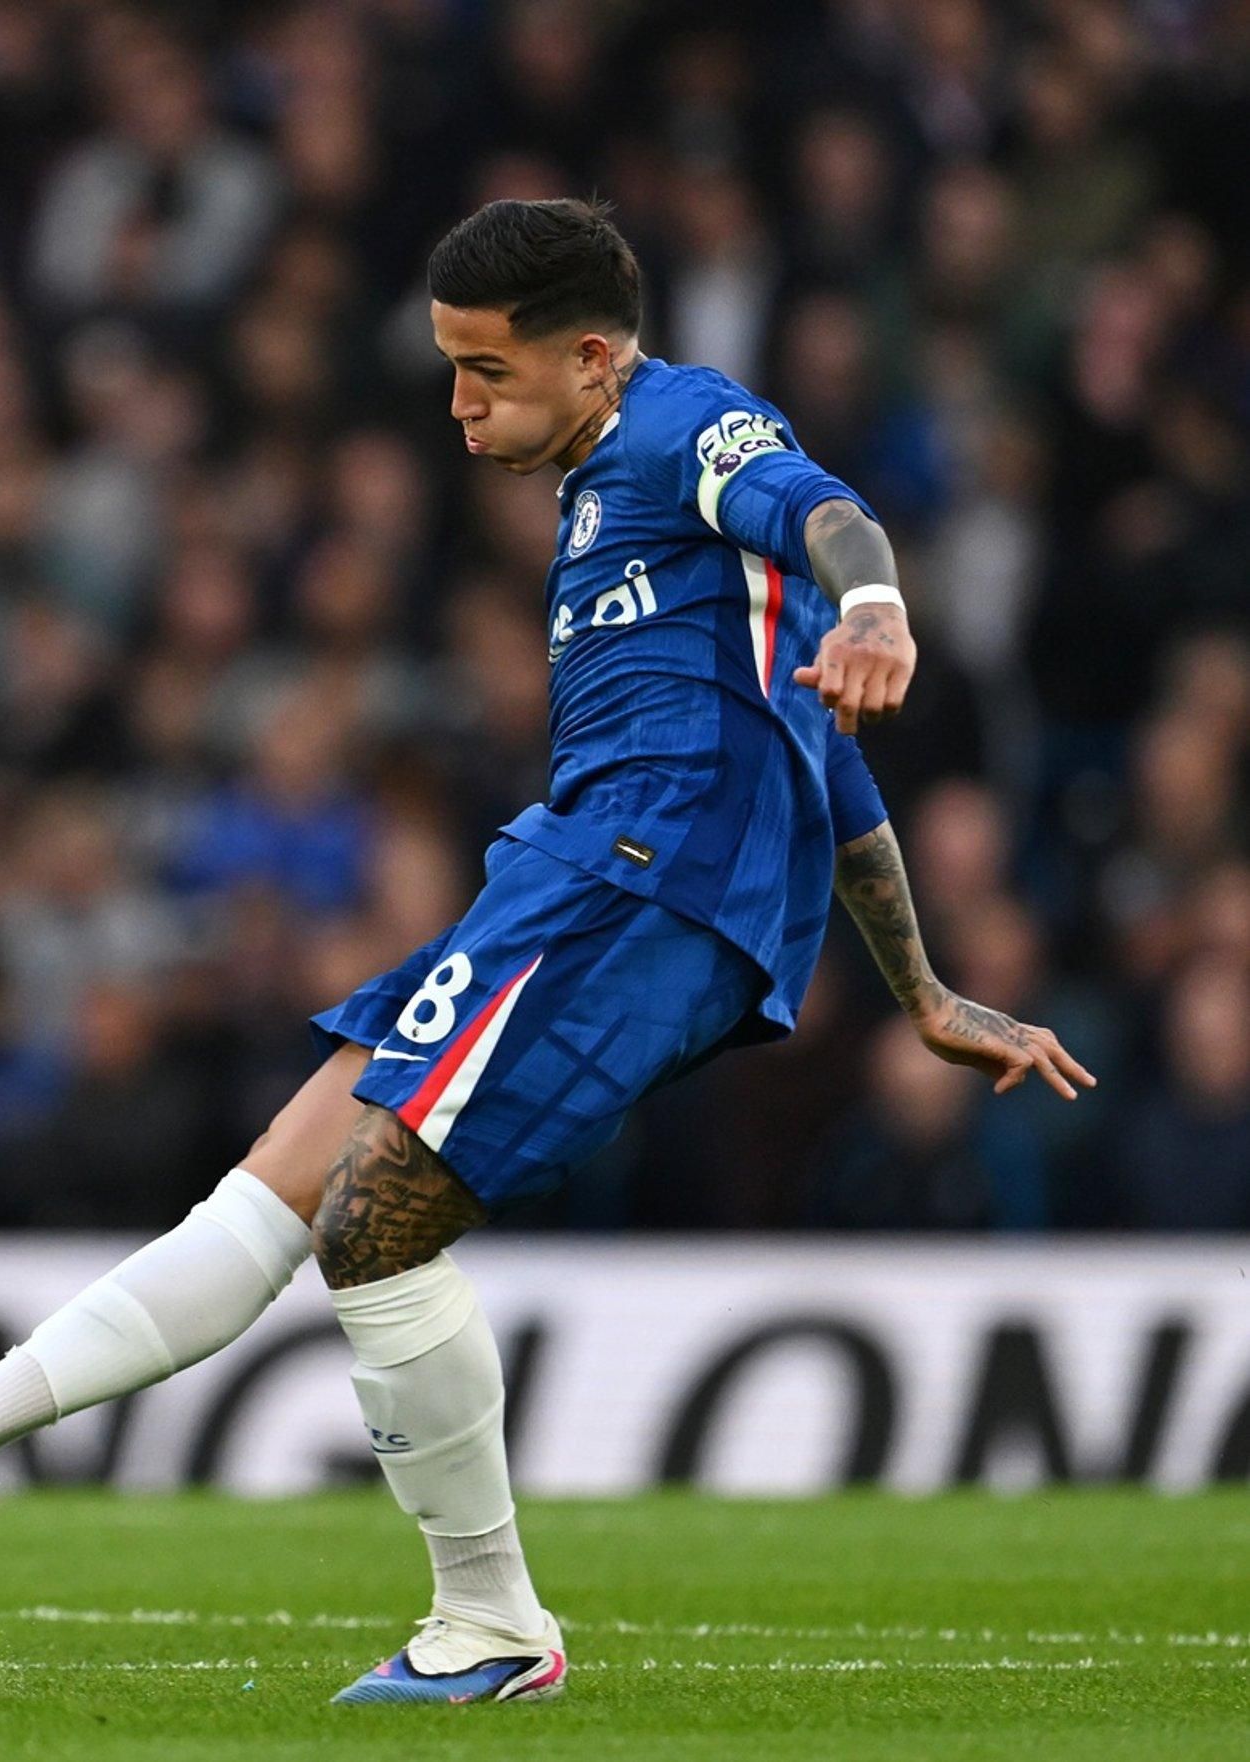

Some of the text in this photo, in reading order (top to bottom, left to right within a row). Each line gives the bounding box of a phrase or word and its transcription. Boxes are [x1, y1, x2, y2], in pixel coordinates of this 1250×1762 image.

[739, 440, 779, 453] Ca
[396, 952, 473, 1044] 8
[364, 1421, 411, 1446] FC
